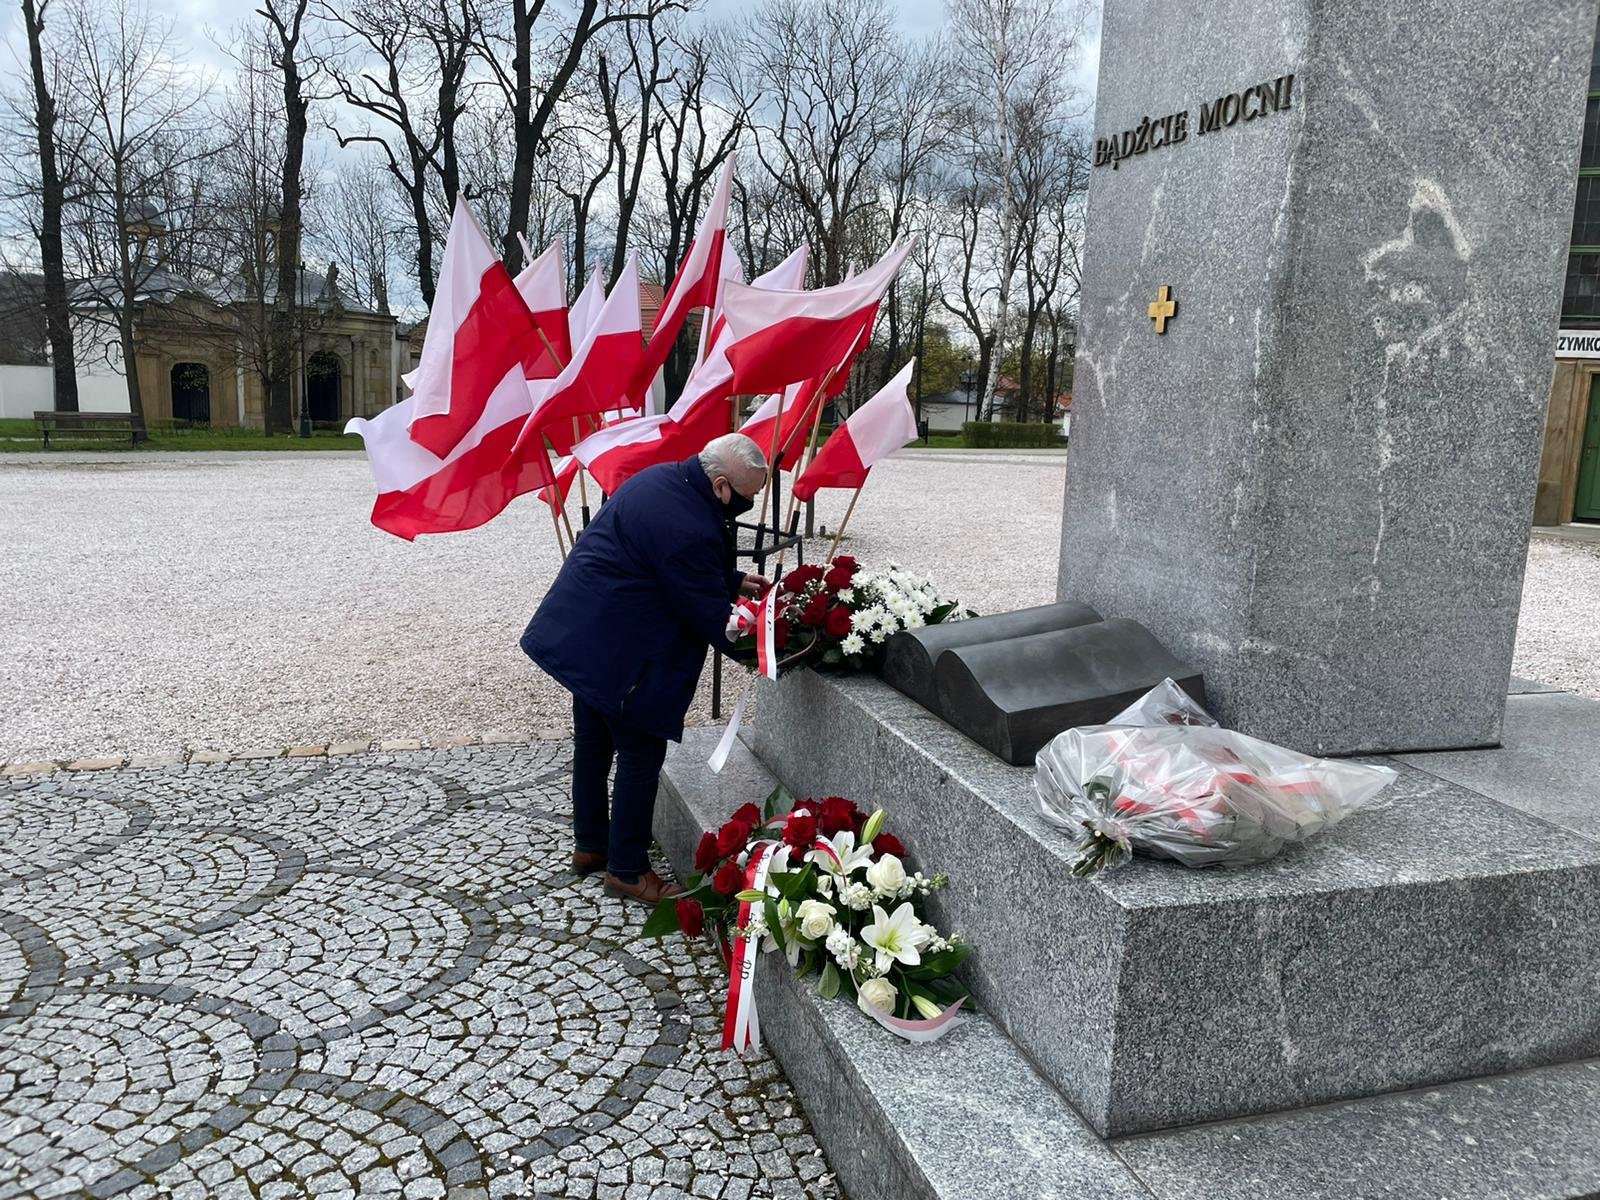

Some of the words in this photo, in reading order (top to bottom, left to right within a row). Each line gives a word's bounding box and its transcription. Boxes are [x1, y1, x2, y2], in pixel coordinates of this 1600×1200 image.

[1094, 111, 1188, 170] BĄDŹCIE
[1197, 74, 1294, 135] MOCNI
[1556, 336, 1600, 352] ZYMKO
